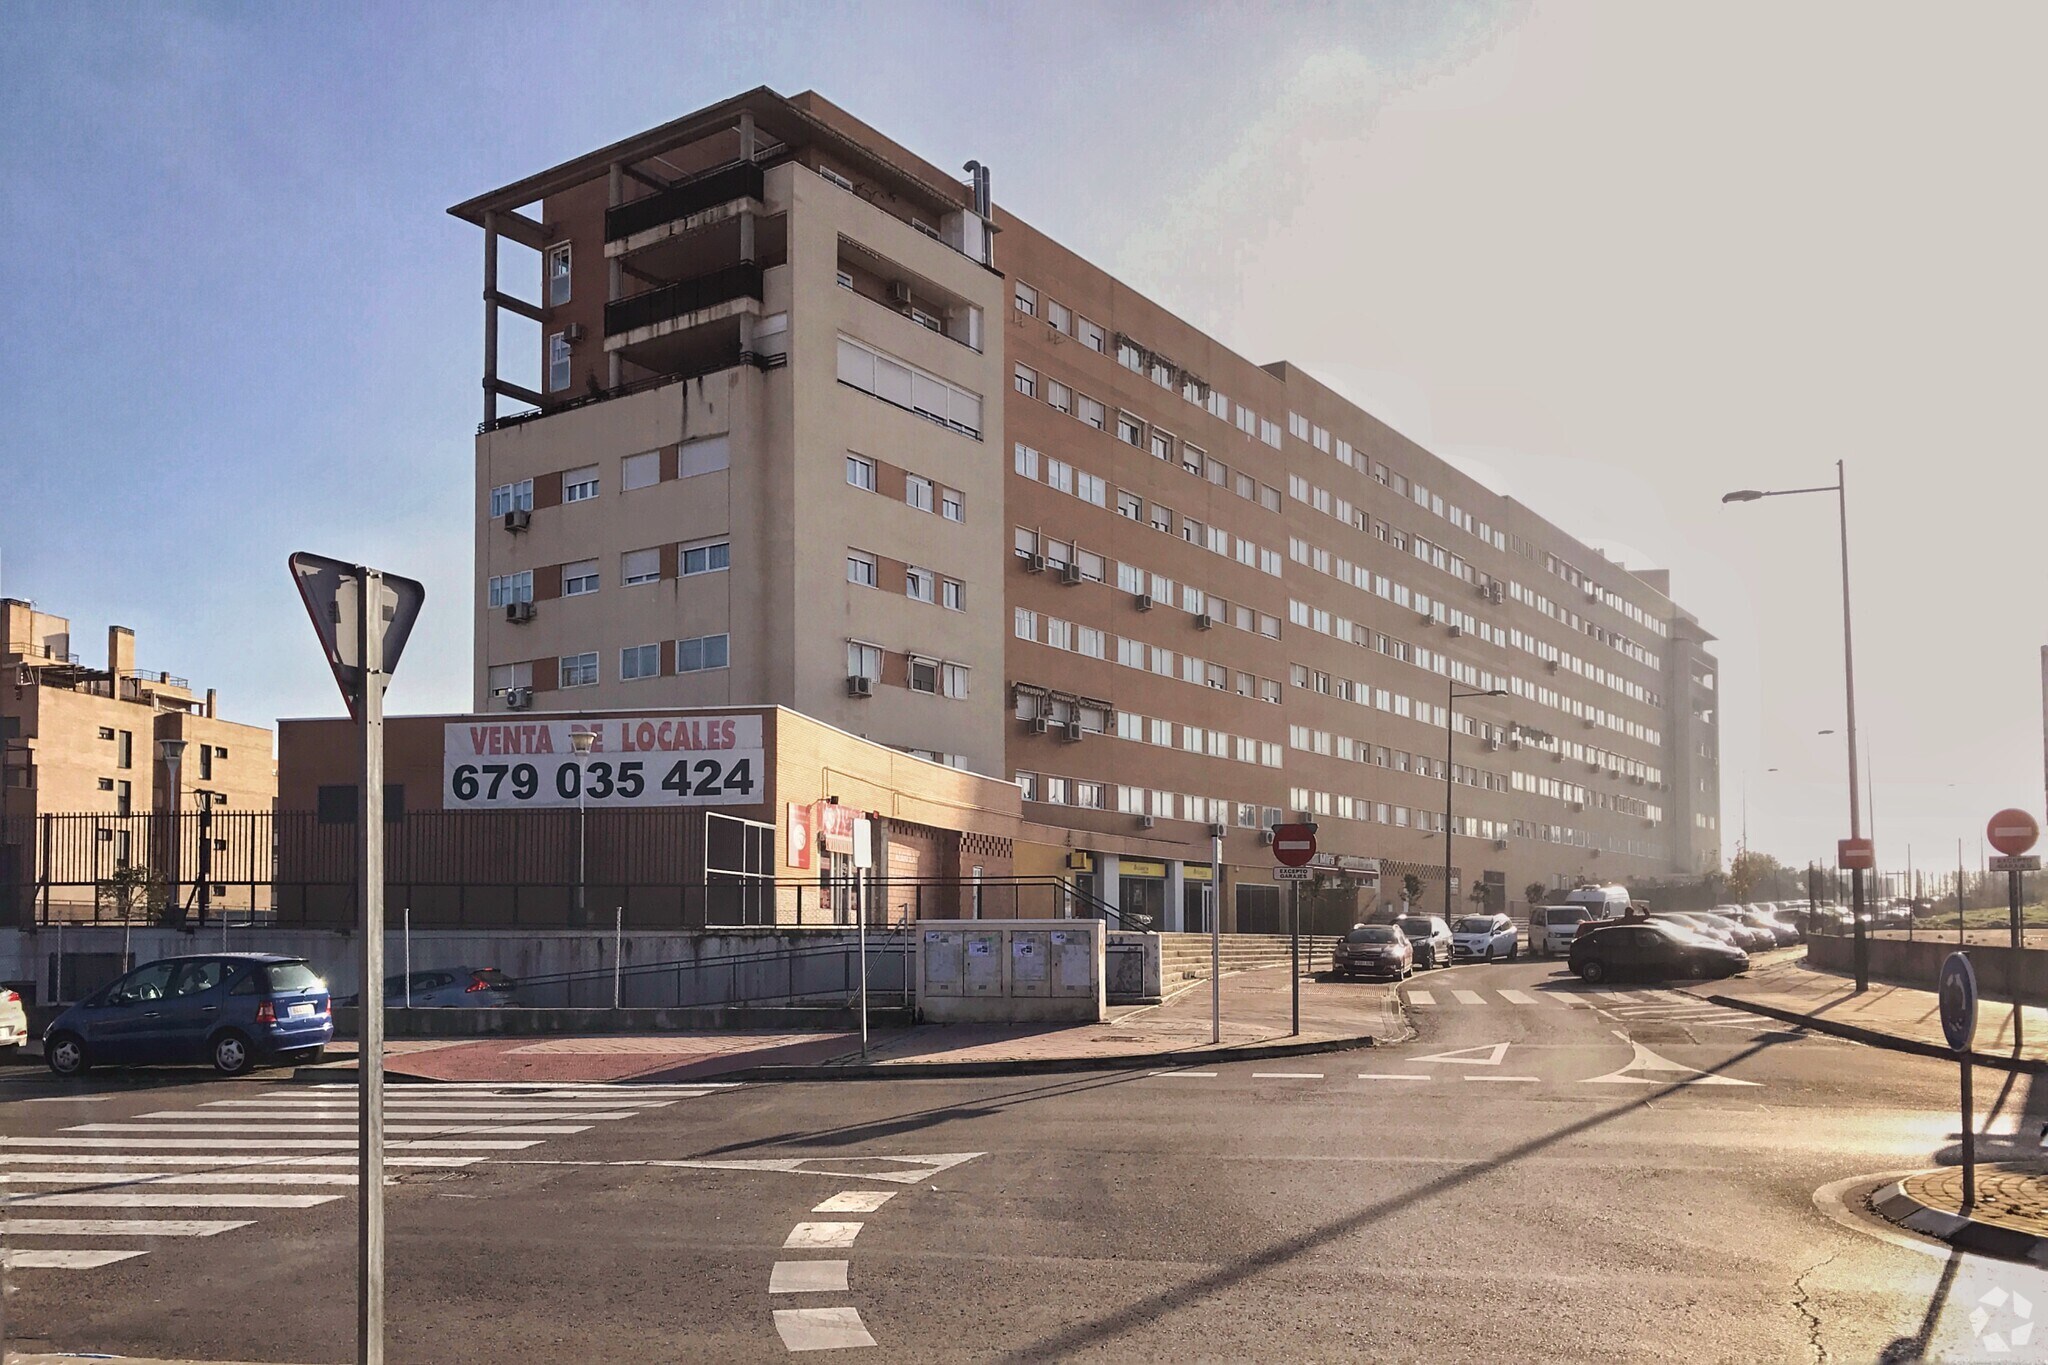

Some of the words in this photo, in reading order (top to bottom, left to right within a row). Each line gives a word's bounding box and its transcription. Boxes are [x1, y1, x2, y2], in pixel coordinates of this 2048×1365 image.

[470, 725, 554, 755] VENTA
[622, 720, 736, 752] LOCALES
[452, 764, 538, 800] 679
[556, 762, 644, 799] 035
[662, 758, 754, 797] 424
